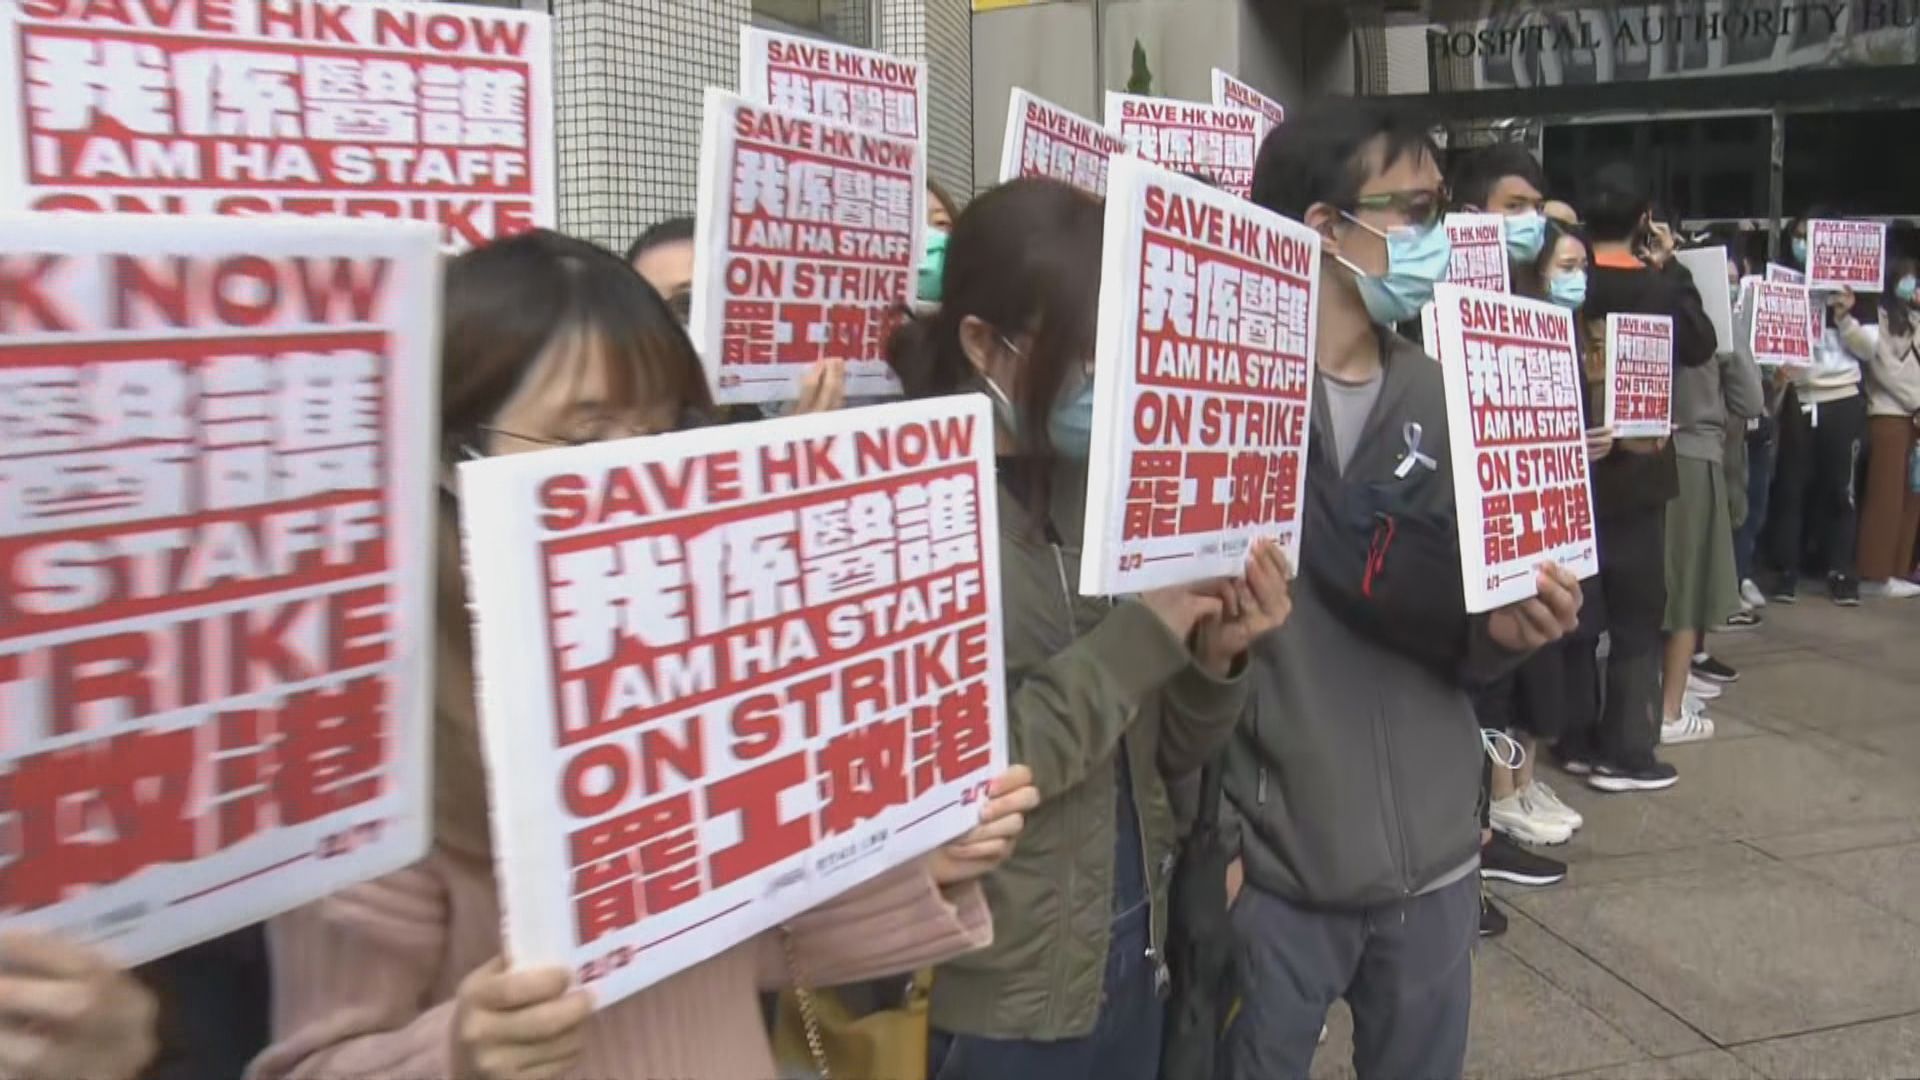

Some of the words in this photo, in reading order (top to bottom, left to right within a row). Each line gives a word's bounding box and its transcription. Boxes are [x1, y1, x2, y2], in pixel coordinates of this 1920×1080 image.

[260, 0, 360, 44] HK
[377, 12, 530, 55] NOW
[1614, 3, 1848, 46] AUTHORITY
[24, 36, 527, 148] 我係醫護
[767, 40, 831, 72] SAVE
[835, 50, 867, 78] HK
[869, 60, 918, 87] NOW
[734, 105, 813, 149] SAVE
[820, 125, 857, 157] HK
[859, 134, 912, 171] NOW
[1026, 100, 1068, 134] SAVE
[1069, 120, 1091, 146] HK
[1093, 130, 1128, 154] NOW
[1122, 101, 1177, 122] SAVE
[1182, 108, 1208, 125] HK
[1211, 111, 1256, 132] NOW
[33, 135, 61, 176] I
[75, 138, 197, 181] AM
[216, 142, 321, 184] HA
[329, 147, 526, 187] STAFF
[1208, 166, 1252, 186] TAFF
[733, 150, 912, 235] 我係醫護
[746, 220, 794, 252] AM
[798, 225, 835, 255] HA
[838, 230, 911, 262] STAFF
[1144, 184, 1224, 246] SAVE
[1228, 213, 1263, 261] HK
[1264, 230, 1312, 277] NOW
[1475, 224, 1499, 240] NOW
[110, 256, 391, 330] NOW
[725, 257, 784, 298] ON
[793, 263, 909, 304] STRIKE
[1140, 242, 1308, 358] 我係醫護
[1459, 297, 1510, 333] SAVE
[1512, 307, 1535, 334] HK
[1536, 313, 1568, 342] NOW
[1140, 339, 1150, 376] I
[1154, 343, 1201, 383] AM
[1206, 348, 1242, 386] HA
[1244, 354, 1307, 393] STAFF
[1466, 338, 1577, 408] 我係醫護
[1133, 390, 1193, 447] ON
[1200, 396, 1306, 449] STRIKE
[1482, 408, 1510, 438] AM
[1513, 410, 1535, 438] HA
[1538, 411, 1579, 440] STAFF
[537, 449, 744, 532] SAVE
[758, 435, 846, 495] HK
[854, 414, 976, 476] NOW
[1122, 450, 1299, 541] 罷工救港
[1477, 458, 1512, 493] ON
[1516, 446, 1585, 486] STRIKE
[1482, 482, 1592, 566] 罷工救港
[11, 500, 381, 616] STAFF
[548, 472, 980, 672] 我係醫護
[561, 680, 588, 734] I
[602, 650, 716, 720] AM
[727, 620, 819, 685] HA
[826, 572, 981, 652] STAFF
[560, 713, 708, 817] ON
[729, 620, 989, 760] STRIKE
[566, 682, 992, 948] 罷工救港
